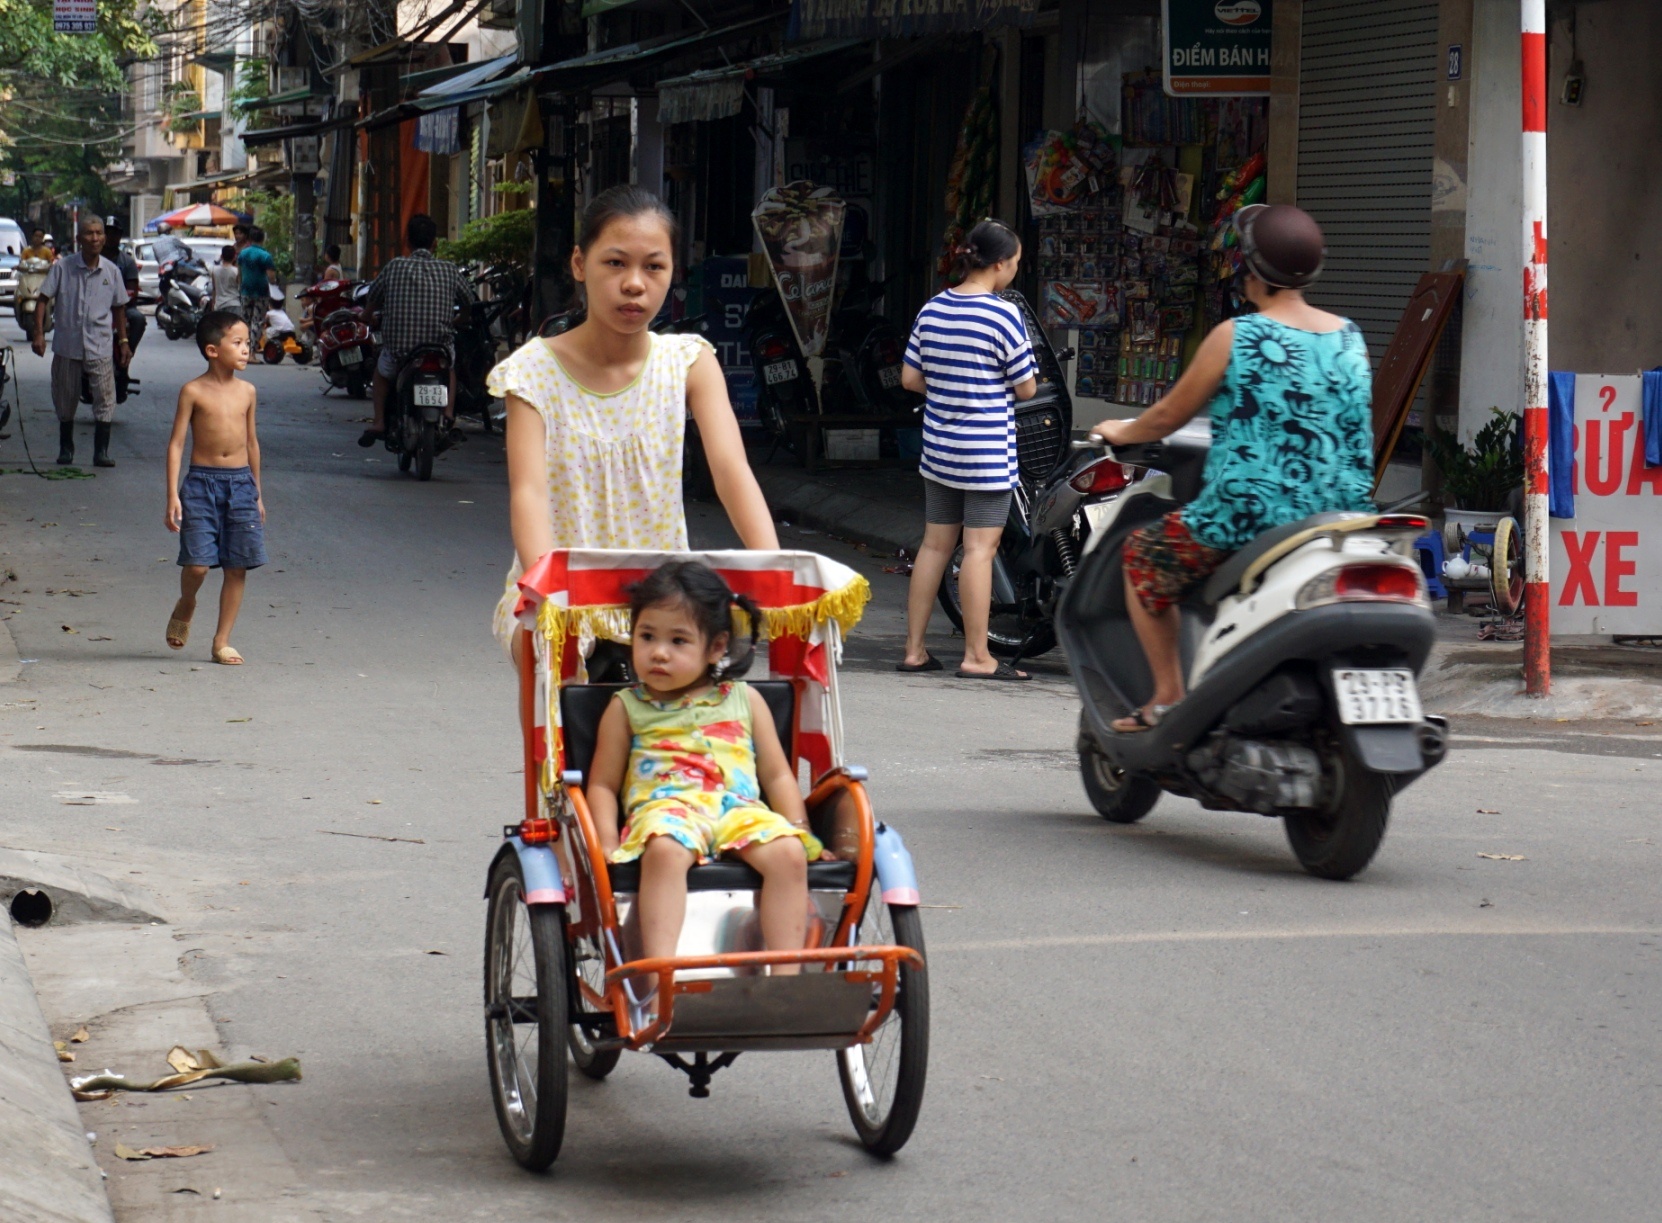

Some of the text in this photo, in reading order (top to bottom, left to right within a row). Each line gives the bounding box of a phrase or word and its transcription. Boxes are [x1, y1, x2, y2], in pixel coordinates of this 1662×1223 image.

[1172, 42, 1215, 66] ĐIỂM
[1219, 44, 1253, 66] BÁN
[1449, 52, 1459, 74] 28
[717, 341, 752, 366] TH
[418, 386, 442, 395] 29-X3
[419, 395, 442, 406] 1654
[1558, 531, 1639, 607] XE
